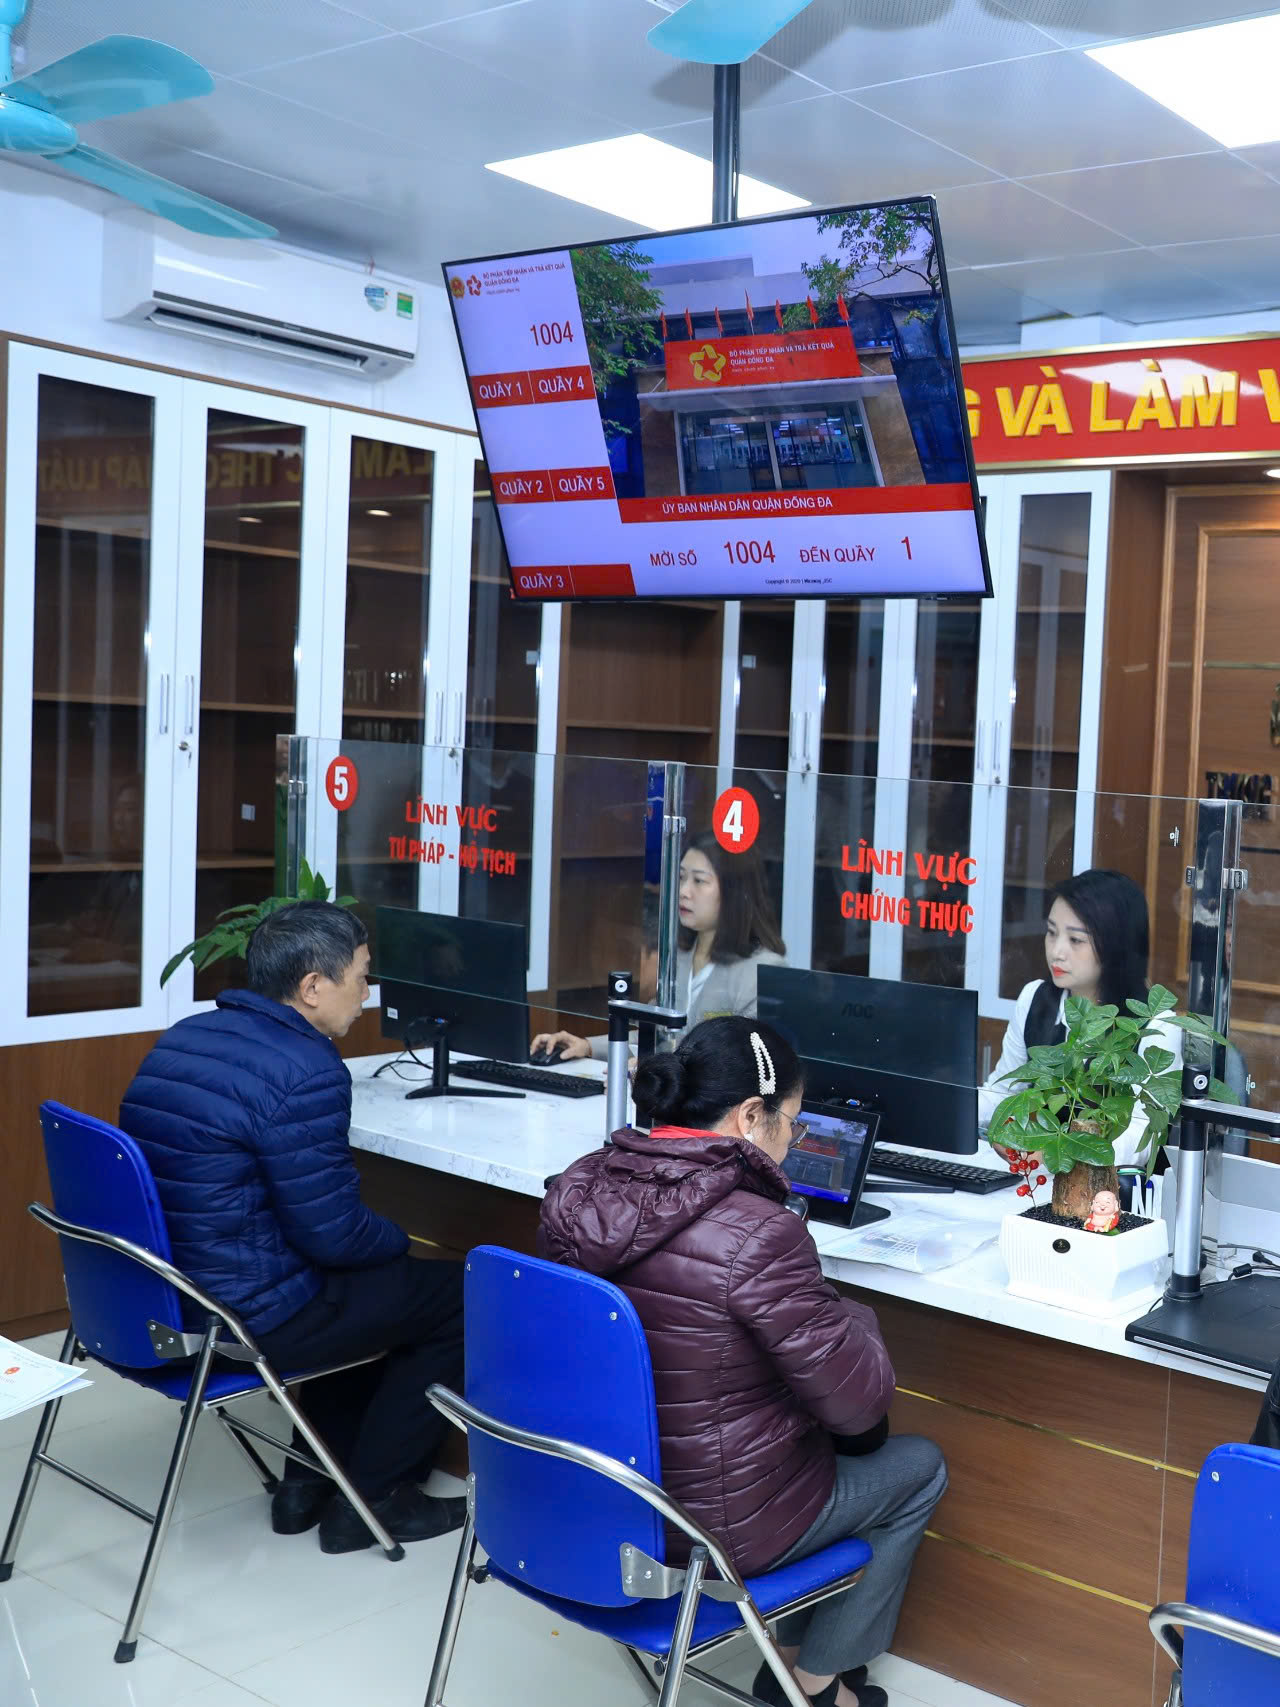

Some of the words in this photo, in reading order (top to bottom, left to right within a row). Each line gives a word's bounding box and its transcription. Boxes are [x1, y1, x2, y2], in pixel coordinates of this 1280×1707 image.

[529, 320, 574, 348] 1004
[478, 379, 516, 402] QUẦY
[516, 382, 523, 395] 1
[537, 375, 575, 395] QUẦY
[576, 377, 586, 392] 4
[996, 365, 1073, 437] VÀ
[1089, 358, 1238, 433] LÀM
[499, 475, 533, 497] QUẦY
[534, 478, 544, 493] 2
[558, 474, 593, 493] QUẦY
[596, 476, 605, 491] 5
[662, 501, 675, 514] ỦY
[678, 503, 698, 513] BAN
[699, 500, 727, 513] NHÂN
[729, 498, 750, 511] DÂN
[752, 497, 782, 512] QUẬN
[817, 496, 833, 507] ĐA
[650, 548, 675, 567] MỜI
[679, 549, 697, 566] SỐ
[723, 540, 776, 564] 1004
[799, 546, 830, 563] ĐẾN
[834, 544, 875, 563] QUẦY
[901, 536, 912, 560] 1
[520, 571, 553, 590] QUẦY
[555, 574, 564, 588] 3
[334, 765, 348, 801] 5
[405, 794, 448, 826] LĨNH
[455, 803, 497, 837] VỰC
[721, 800, 744, 842] 4
[388, 834, 407, 860] TƯ
[409, 836, 445, 865] PHÁP
[459, 840, 479, 875] HỘ
[481, 847, 517, 878] TỊCH
[841, 838, 904, 877] LĨNH
[913, 851, 977, 891] VỰC
[840, 888, 911, 926] CHỨNG
[916, 900, 974, 938] THỰC
